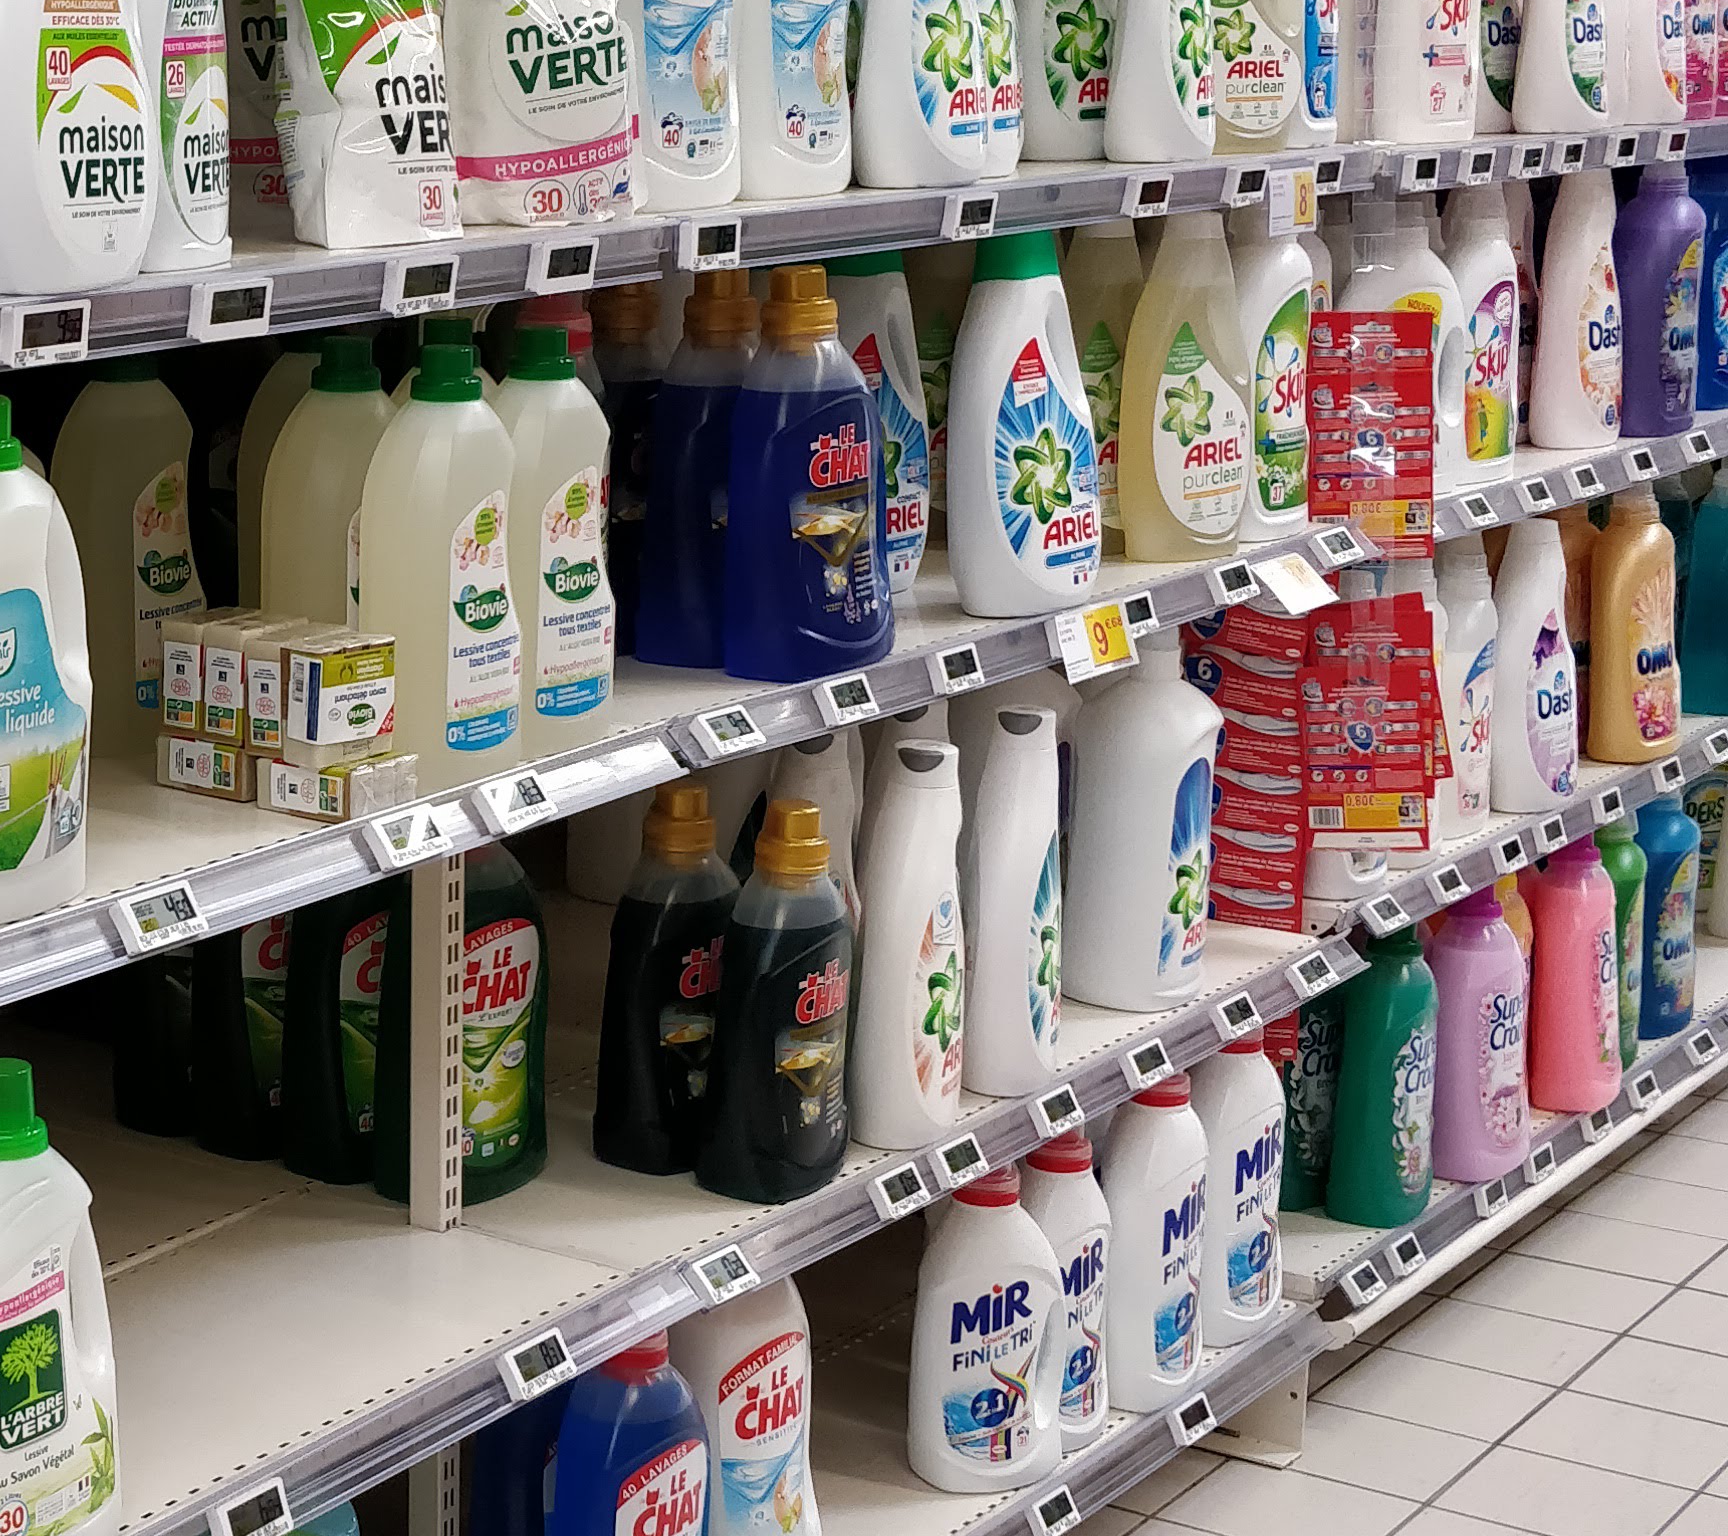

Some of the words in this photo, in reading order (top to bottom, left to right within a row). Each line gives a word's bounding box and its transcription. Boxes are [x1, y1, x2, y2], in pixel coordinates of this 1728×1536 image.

[49, 52, 68, 76] 40
[1227, 60, 1284, 79] ARIEL
[1226, 80, 1285, 97] purclean
[60, 115, 144, 154] maison
[61, 158, 144, 203] VERTE
[1475, 339, 1509, 391] Skip
[1183, 436, 1242, 467] ARIEL
[1182, 466, 1244, 492] purclean
[1043, 510, 1099, 551] ARIEL
[555, 566, 599, 592] Biovie
[465, 598, 508, 624] Biovie
[469, 657, 486, 669] tous
[488, 649, 511, 667] textiles
[5, 706, 55, 734] liquide
[721, 1359, 766, 1395] FORMAT
[766, 1333, 802, 1362] FAMILIAL
[0, 1392, 64, 1427] L'ARBRE
[735, 1376, 804, 1440] CHAT
[1, 1411, 64, 1446] VERT
[11, 1464, 41, 1485] Savon
[42, 1443, 75, 1476] Végétal
